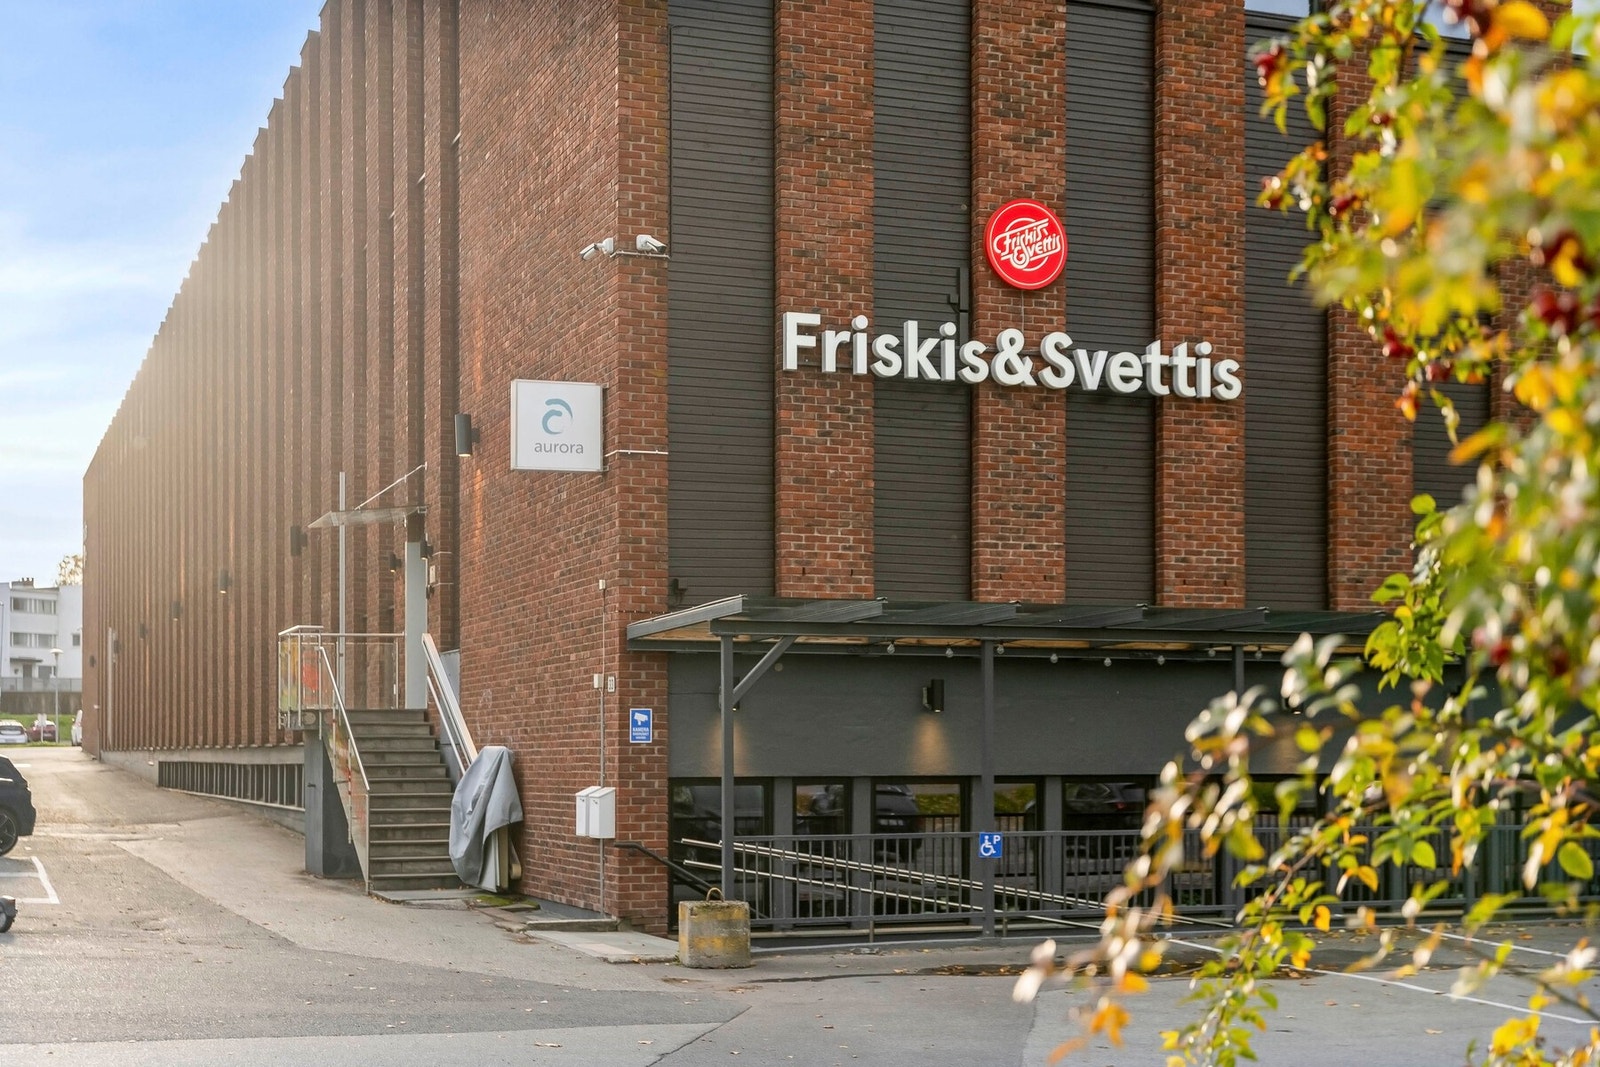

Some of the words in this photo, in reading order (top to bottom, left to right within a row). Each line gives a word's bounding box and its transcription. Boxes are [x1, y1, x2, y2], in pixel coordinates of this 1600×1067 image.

[782, 311, 1243, 401] Friskis&Svettis
[534, 442, 584, 454] aurora
[993, 835, 1001, 844] P
